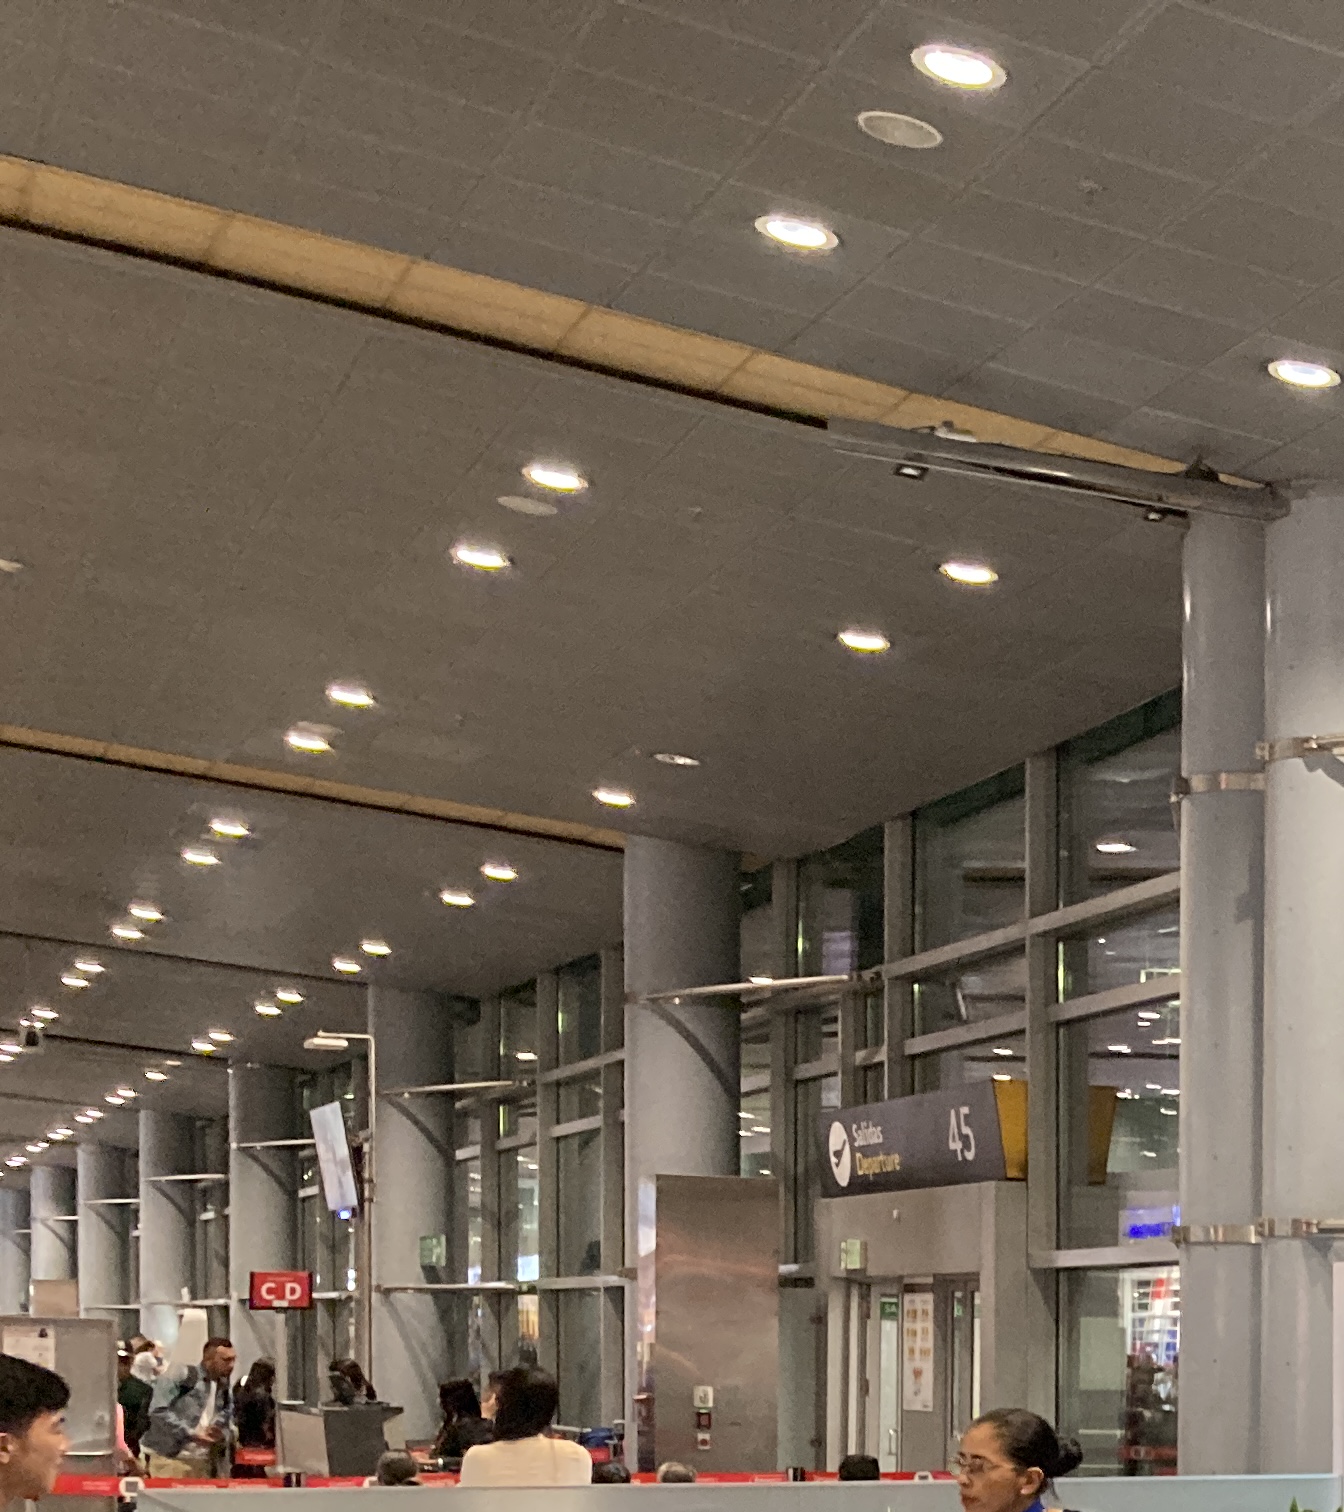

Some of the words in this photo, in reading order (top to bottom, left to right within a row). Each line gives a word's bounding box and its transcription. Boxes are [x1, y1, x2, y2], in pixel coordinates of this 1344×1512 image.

[852, 1119, 883, 1147] Salidas
[948, 1106, 976, 1161] 45
[855, 1151, 901, 1180] Departure
[260, 1282, 277, 1300] C
[285, 1282, 302, 1300] D
